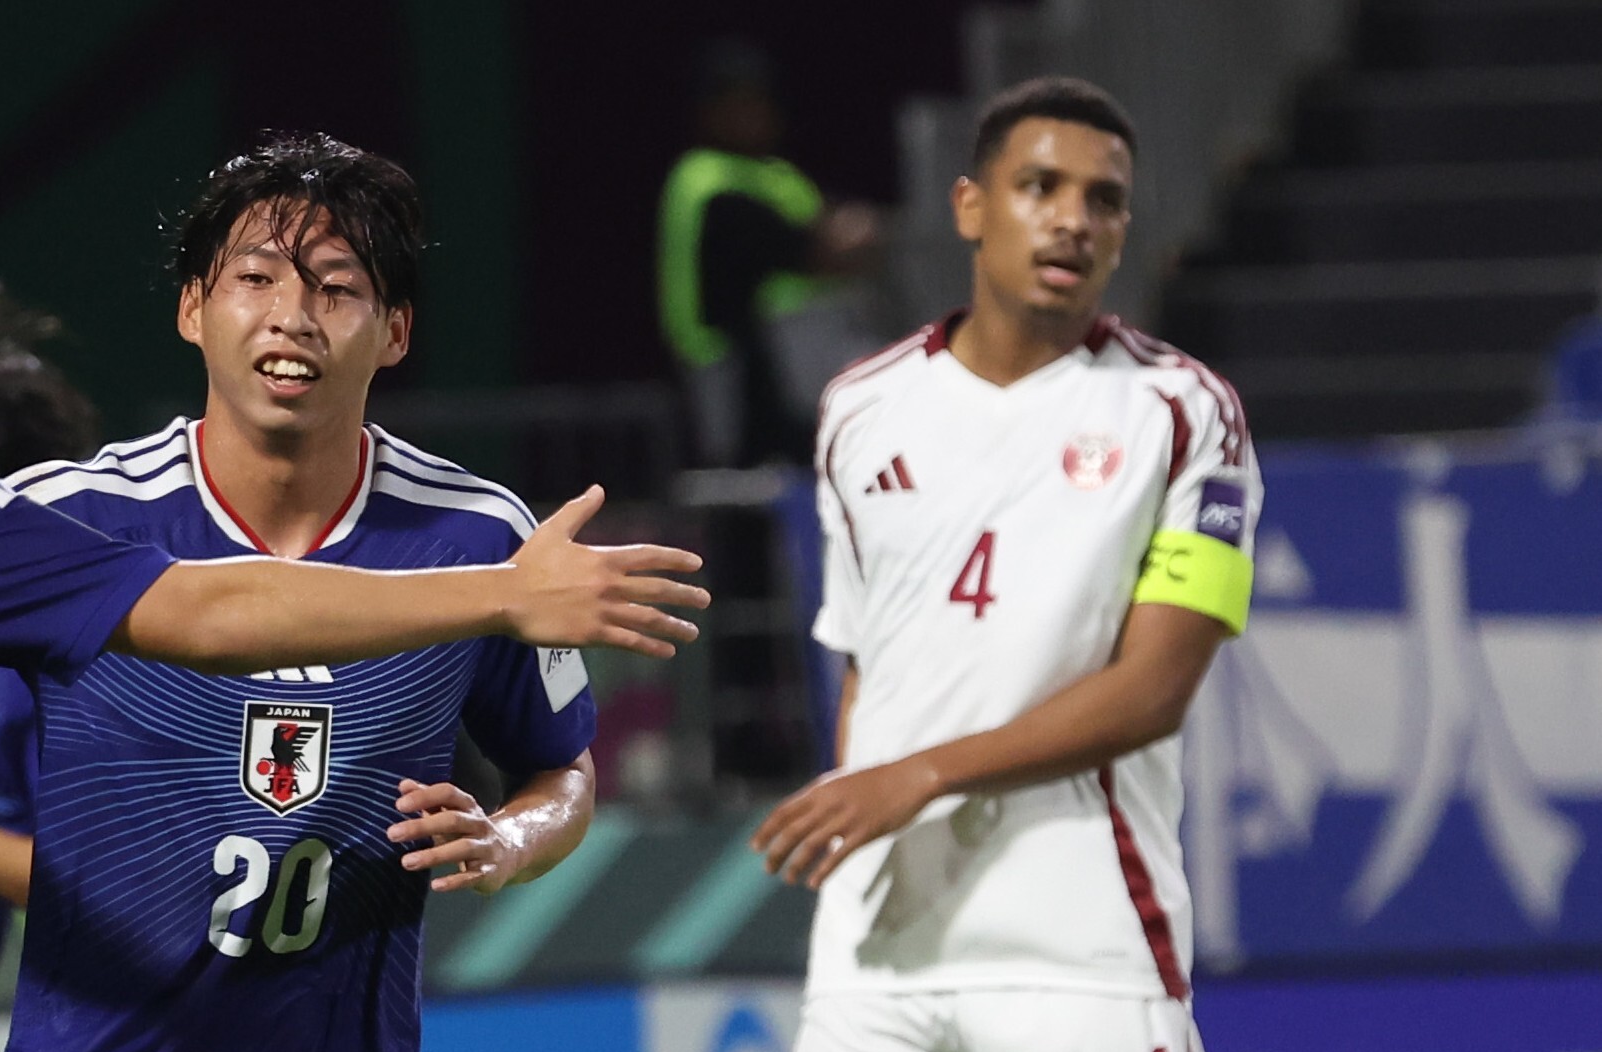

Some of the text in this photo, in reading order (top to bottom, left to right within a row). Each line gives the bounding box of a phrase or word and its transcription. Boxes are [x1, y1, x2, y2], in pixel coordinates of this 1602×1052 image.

[948, 530, 996, 619] 4
[266, 707, 311, 718] JAPAN
[263, 777, 302, 796] JFA
[208, 834, 333, 958] 20
